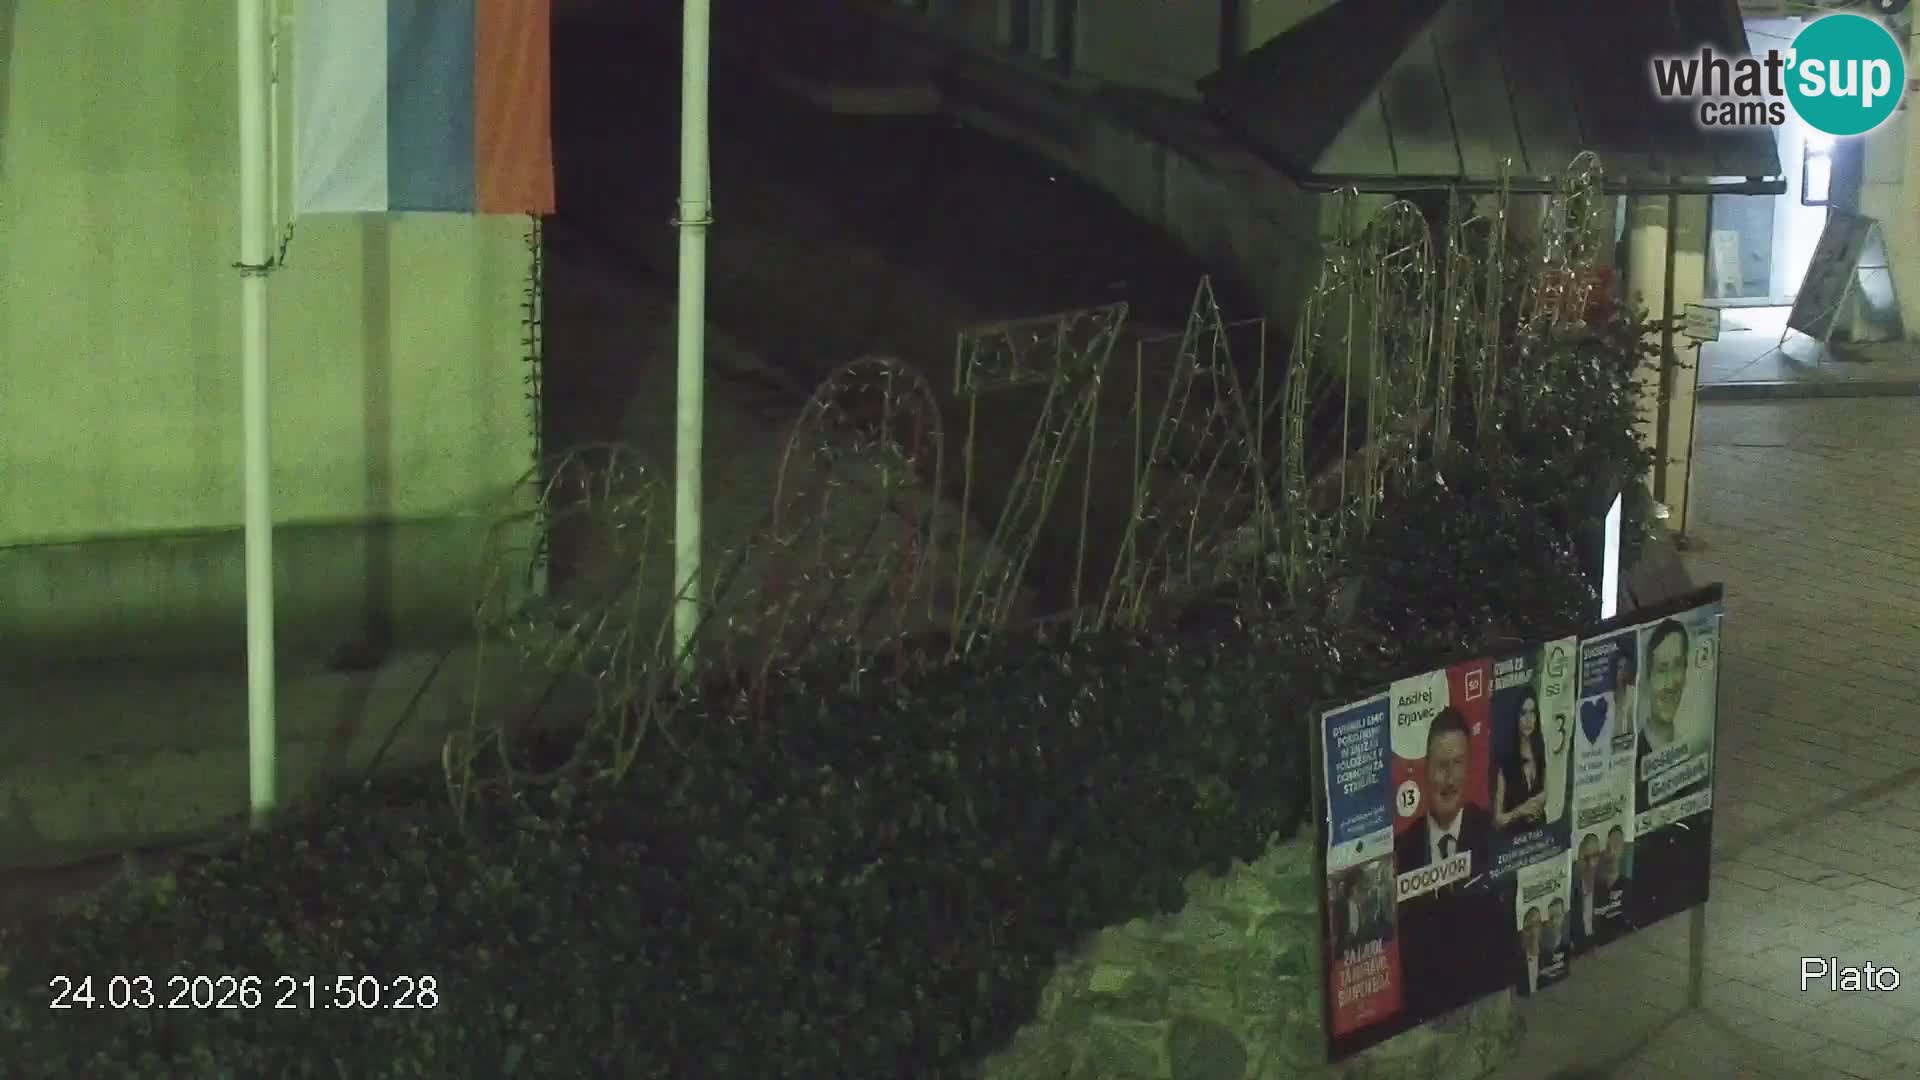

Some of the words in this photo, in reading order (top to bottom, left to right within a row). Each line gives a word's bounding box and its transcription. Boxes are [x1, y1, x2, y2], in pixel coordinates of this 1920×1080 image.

[1398, 686, 1433, 706] Andrej
[1397, 707, 1435, 727] Erjavec
[1553, 713, 1567, 755] 3
[1402, 789, 1416, 809] 13
[1400, 857, 1467, 895] DOGOVOR
